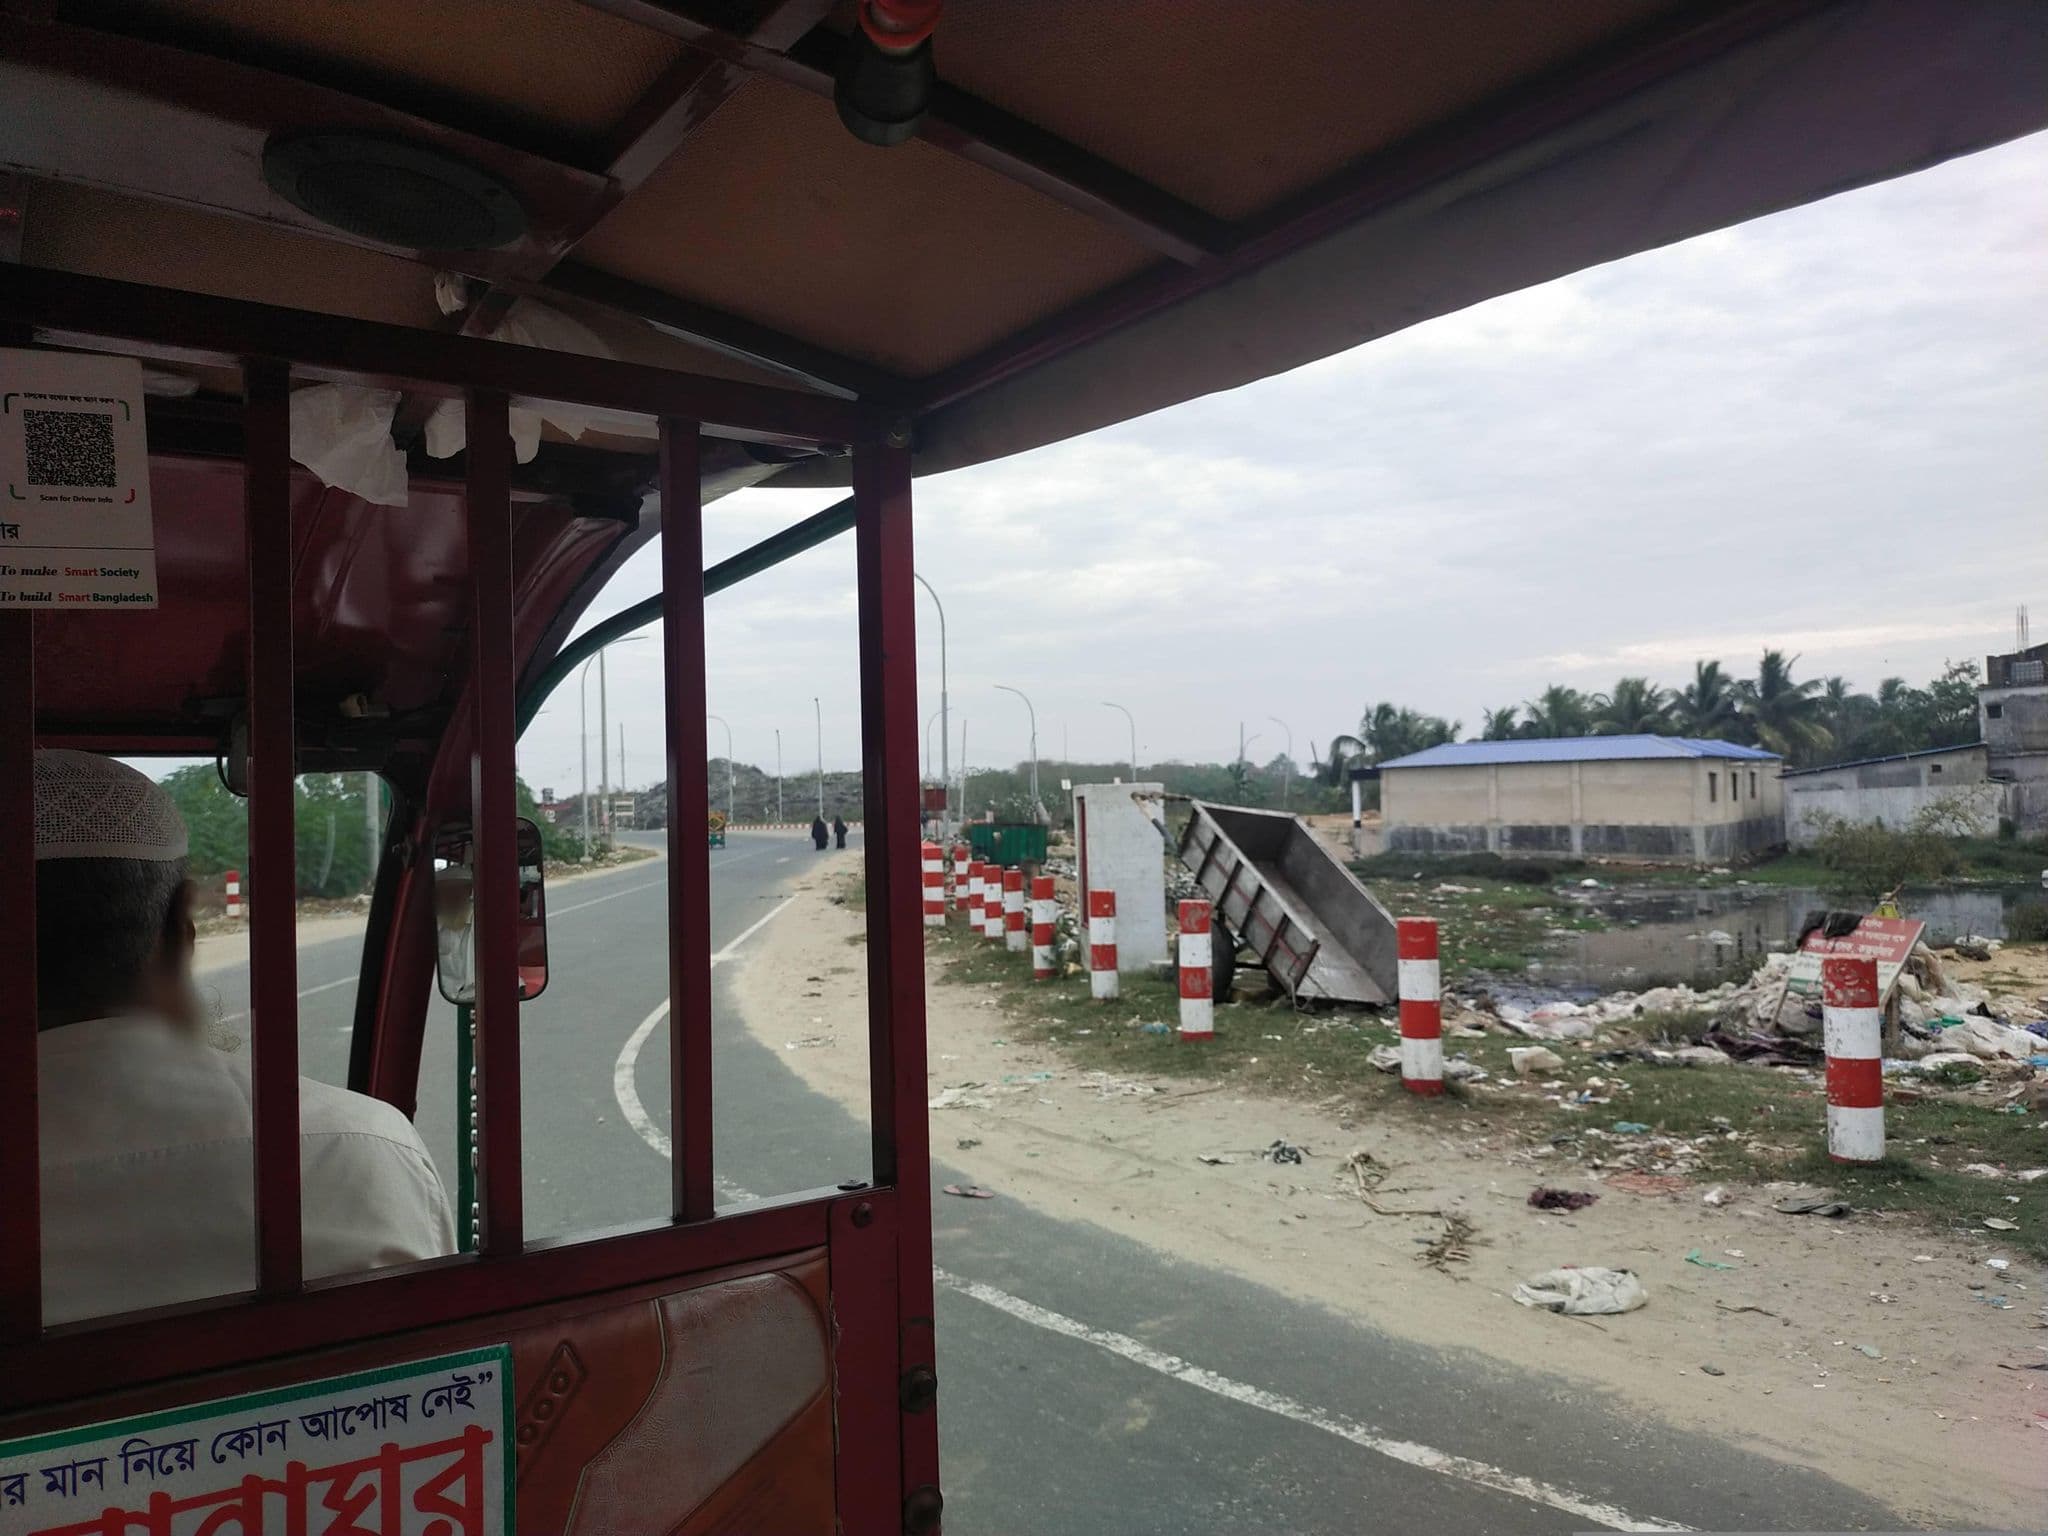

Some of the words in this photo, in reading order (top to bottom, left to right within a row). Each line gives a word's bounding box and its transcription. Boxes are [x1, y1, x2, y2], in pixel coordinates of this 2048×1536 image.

[39, 494, 59, 502] Scan
[60, 494, 71, 502] for
[72, 495, 97, 503] Driver
[0, 521, 21, 540] ার
[0, 565, 17, 576] To
[20, 565, 58, 577] make
[64, 566, 99, 577] Smart
[100, 567, 140, 580] Society
[0, 591, 16, 602] To
[19, 591, 53, 603] build
[58, 592, 91, 603] Smart
[92, 592, 154, 605] Bangladesh
[40, 1456, 109, 1498] মান
[117, 1438, 200, 1485] নিয়ে
[211, 1419, 292, 1465] কোন
[299, 1392, 411, 1443] আপোষ
